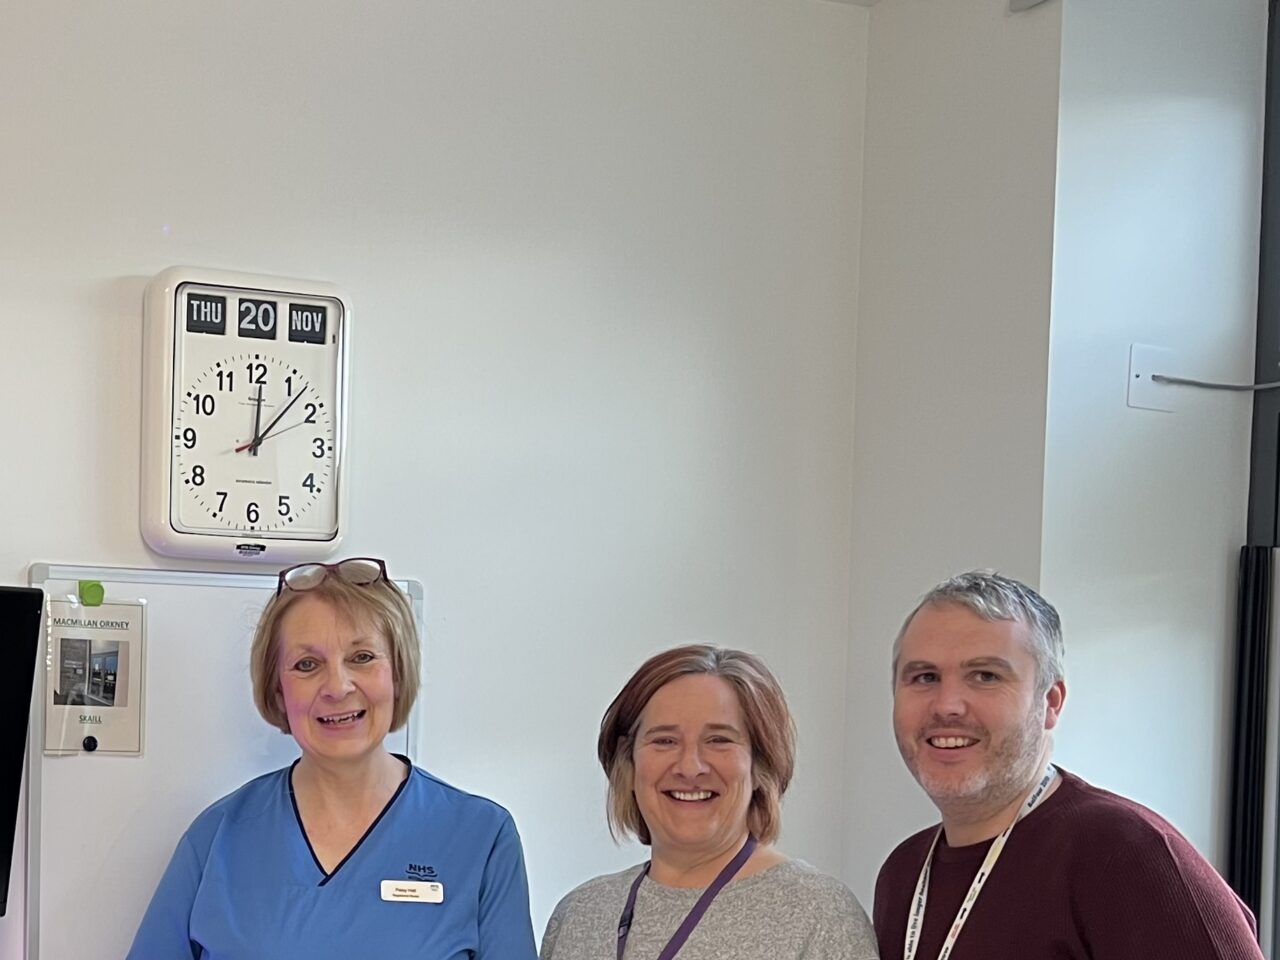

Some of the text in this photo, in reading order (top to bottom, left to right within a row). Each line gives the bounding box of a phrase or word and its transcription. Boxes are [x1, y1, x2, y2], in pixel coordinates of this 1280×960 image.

[191, 300, 323, 332] THU 20 NOV
[216, 370, 233, 392] 11
[246, 363, 267, 385] 12
[285, 376, 292, 396] 1
[192, 394, 215, 416] 10
[304, 403, 317, 424] 2
[183, 428, 196, 449] 9
[312, 438, 325, 458] 3
[192, 465, 205, 486] 8
[302, 473, 315, 493] 4
[216, 492, 227, 512] 7
[278, 496, 290, 516] 5
[246, 503, 259, 523] 6
[53, 617, 129, 630] MACMILLAN ORKNEY
[408, 863, 435, 875] NHS
